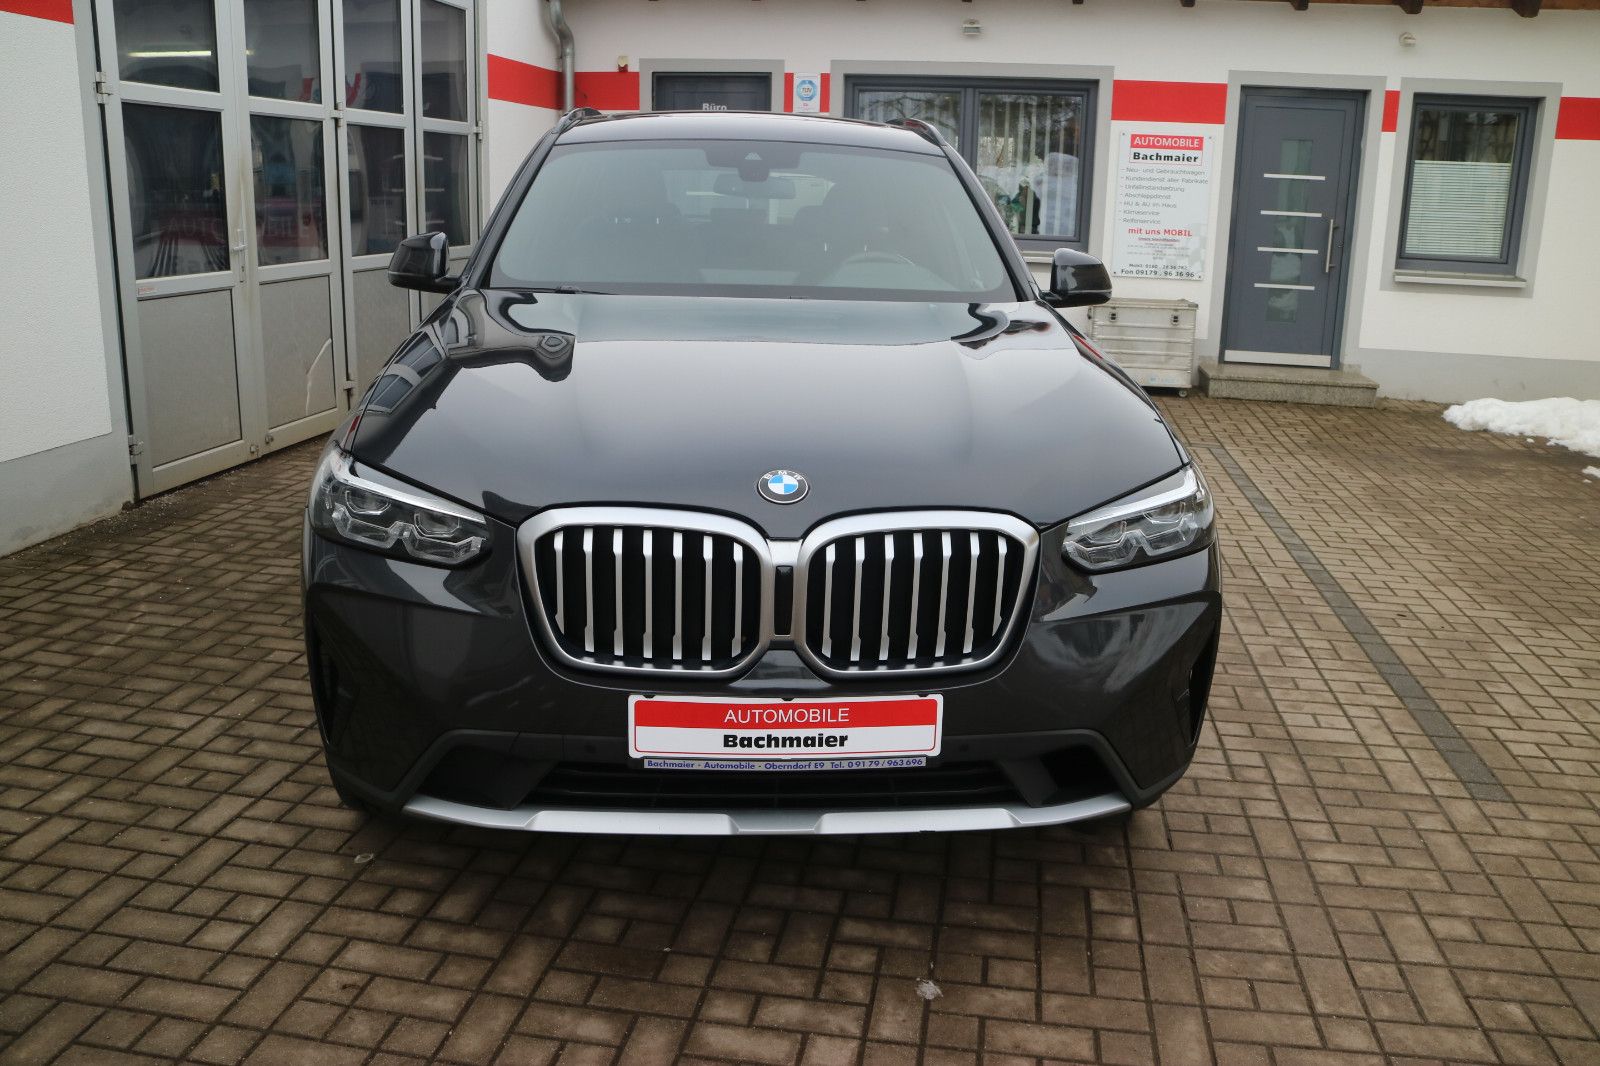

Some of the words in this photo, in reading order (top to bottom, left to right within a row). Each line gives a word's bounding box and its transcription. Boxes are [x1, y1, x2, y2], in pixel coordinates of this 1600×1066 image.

[702, 103, 728, 111] Büro
[1133, 136, 1200, 148] AUTOMOBILE
[1133, 152, 1199, 163] Bachmaier
[1156, 168, 1206, 176] Gebrauchtwagen
[1124, 192, 1172, 200] Abschleppdienst
[1163, 229, 1193, 237] MOBIL
[763, 470, 803, 480] BMW
[723, 707, 851, 724] AUTOMOBILE
[723, 733, 849, 749] Bachmaier
[647, 760, 695, 768] Bachmaier
[703, 761, 755, 770] Automobile
[764, 762, 812, 770] Oberndorf
